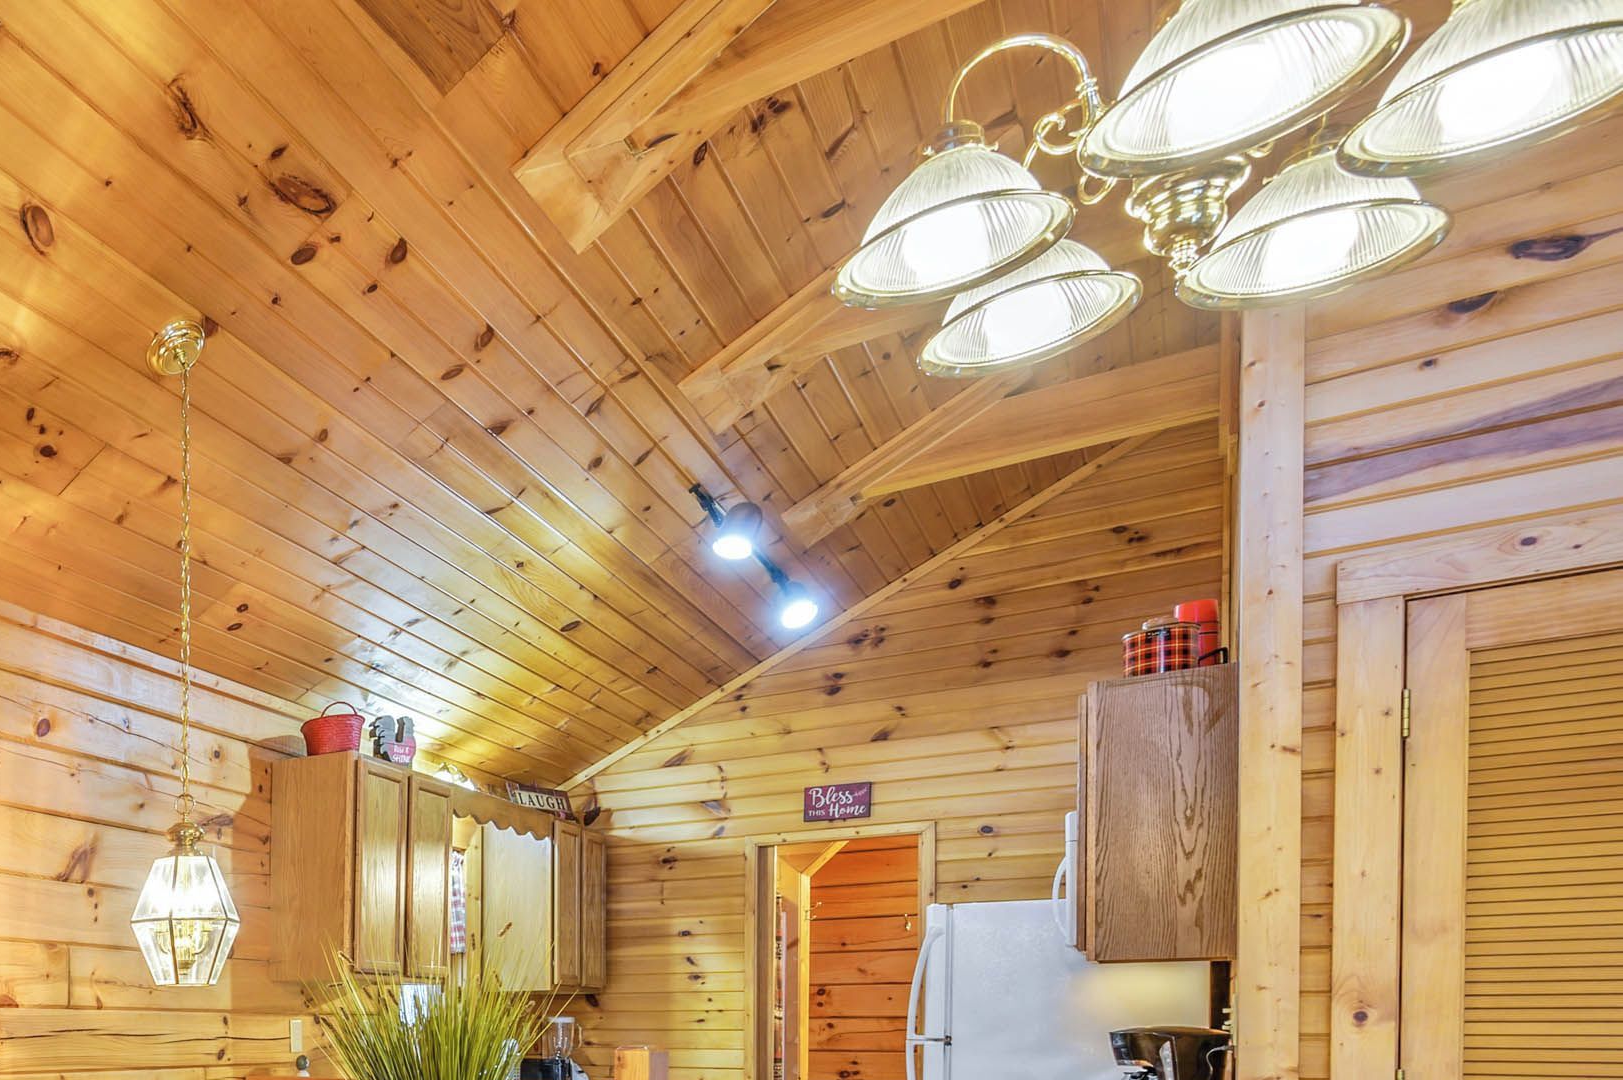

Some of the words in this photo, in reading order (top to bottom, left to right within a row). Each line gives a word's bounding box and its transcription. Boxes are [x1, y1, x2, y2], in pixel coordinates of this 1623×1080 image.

[518, 792, 566, 810] LAUGH
[808, 786, 853, 808] Bless
[808, 808, 826, 817] THIS
[828, 801, 867, 819] Home
